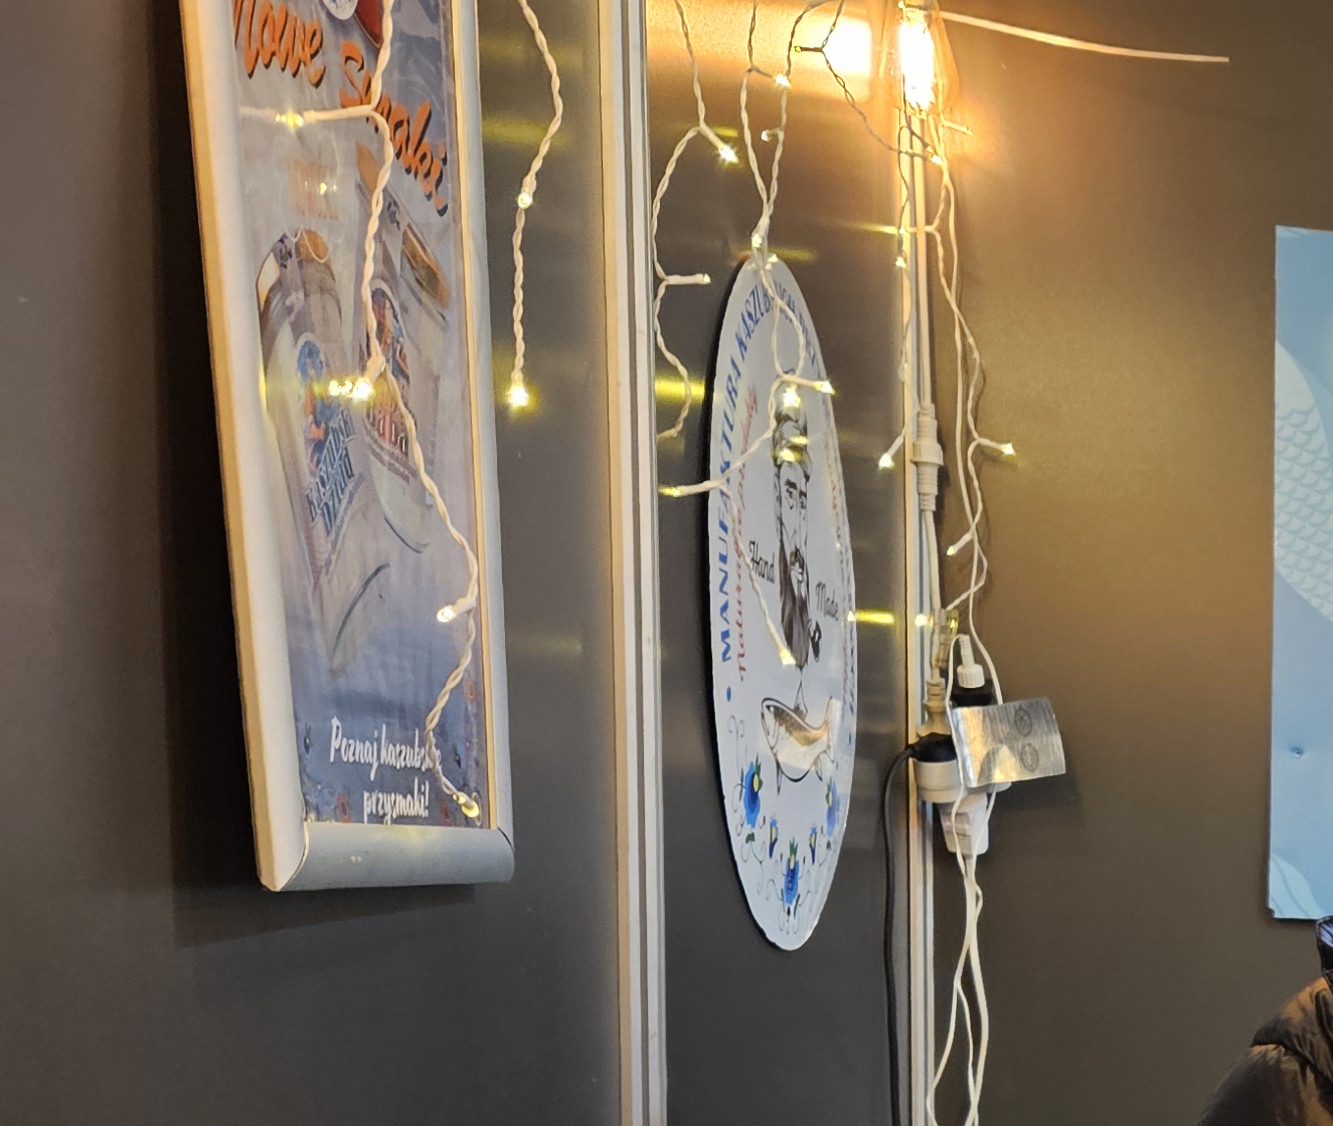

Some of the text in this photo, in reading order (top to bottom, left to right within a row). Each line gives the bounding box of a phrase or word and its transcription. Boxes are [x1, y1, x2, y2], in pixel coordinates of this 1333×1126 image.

[749, 540, 776, 584] Hand
[329, 715, 379, 782] Poznaj
[363, 777, 429, 826] przysmaki!
